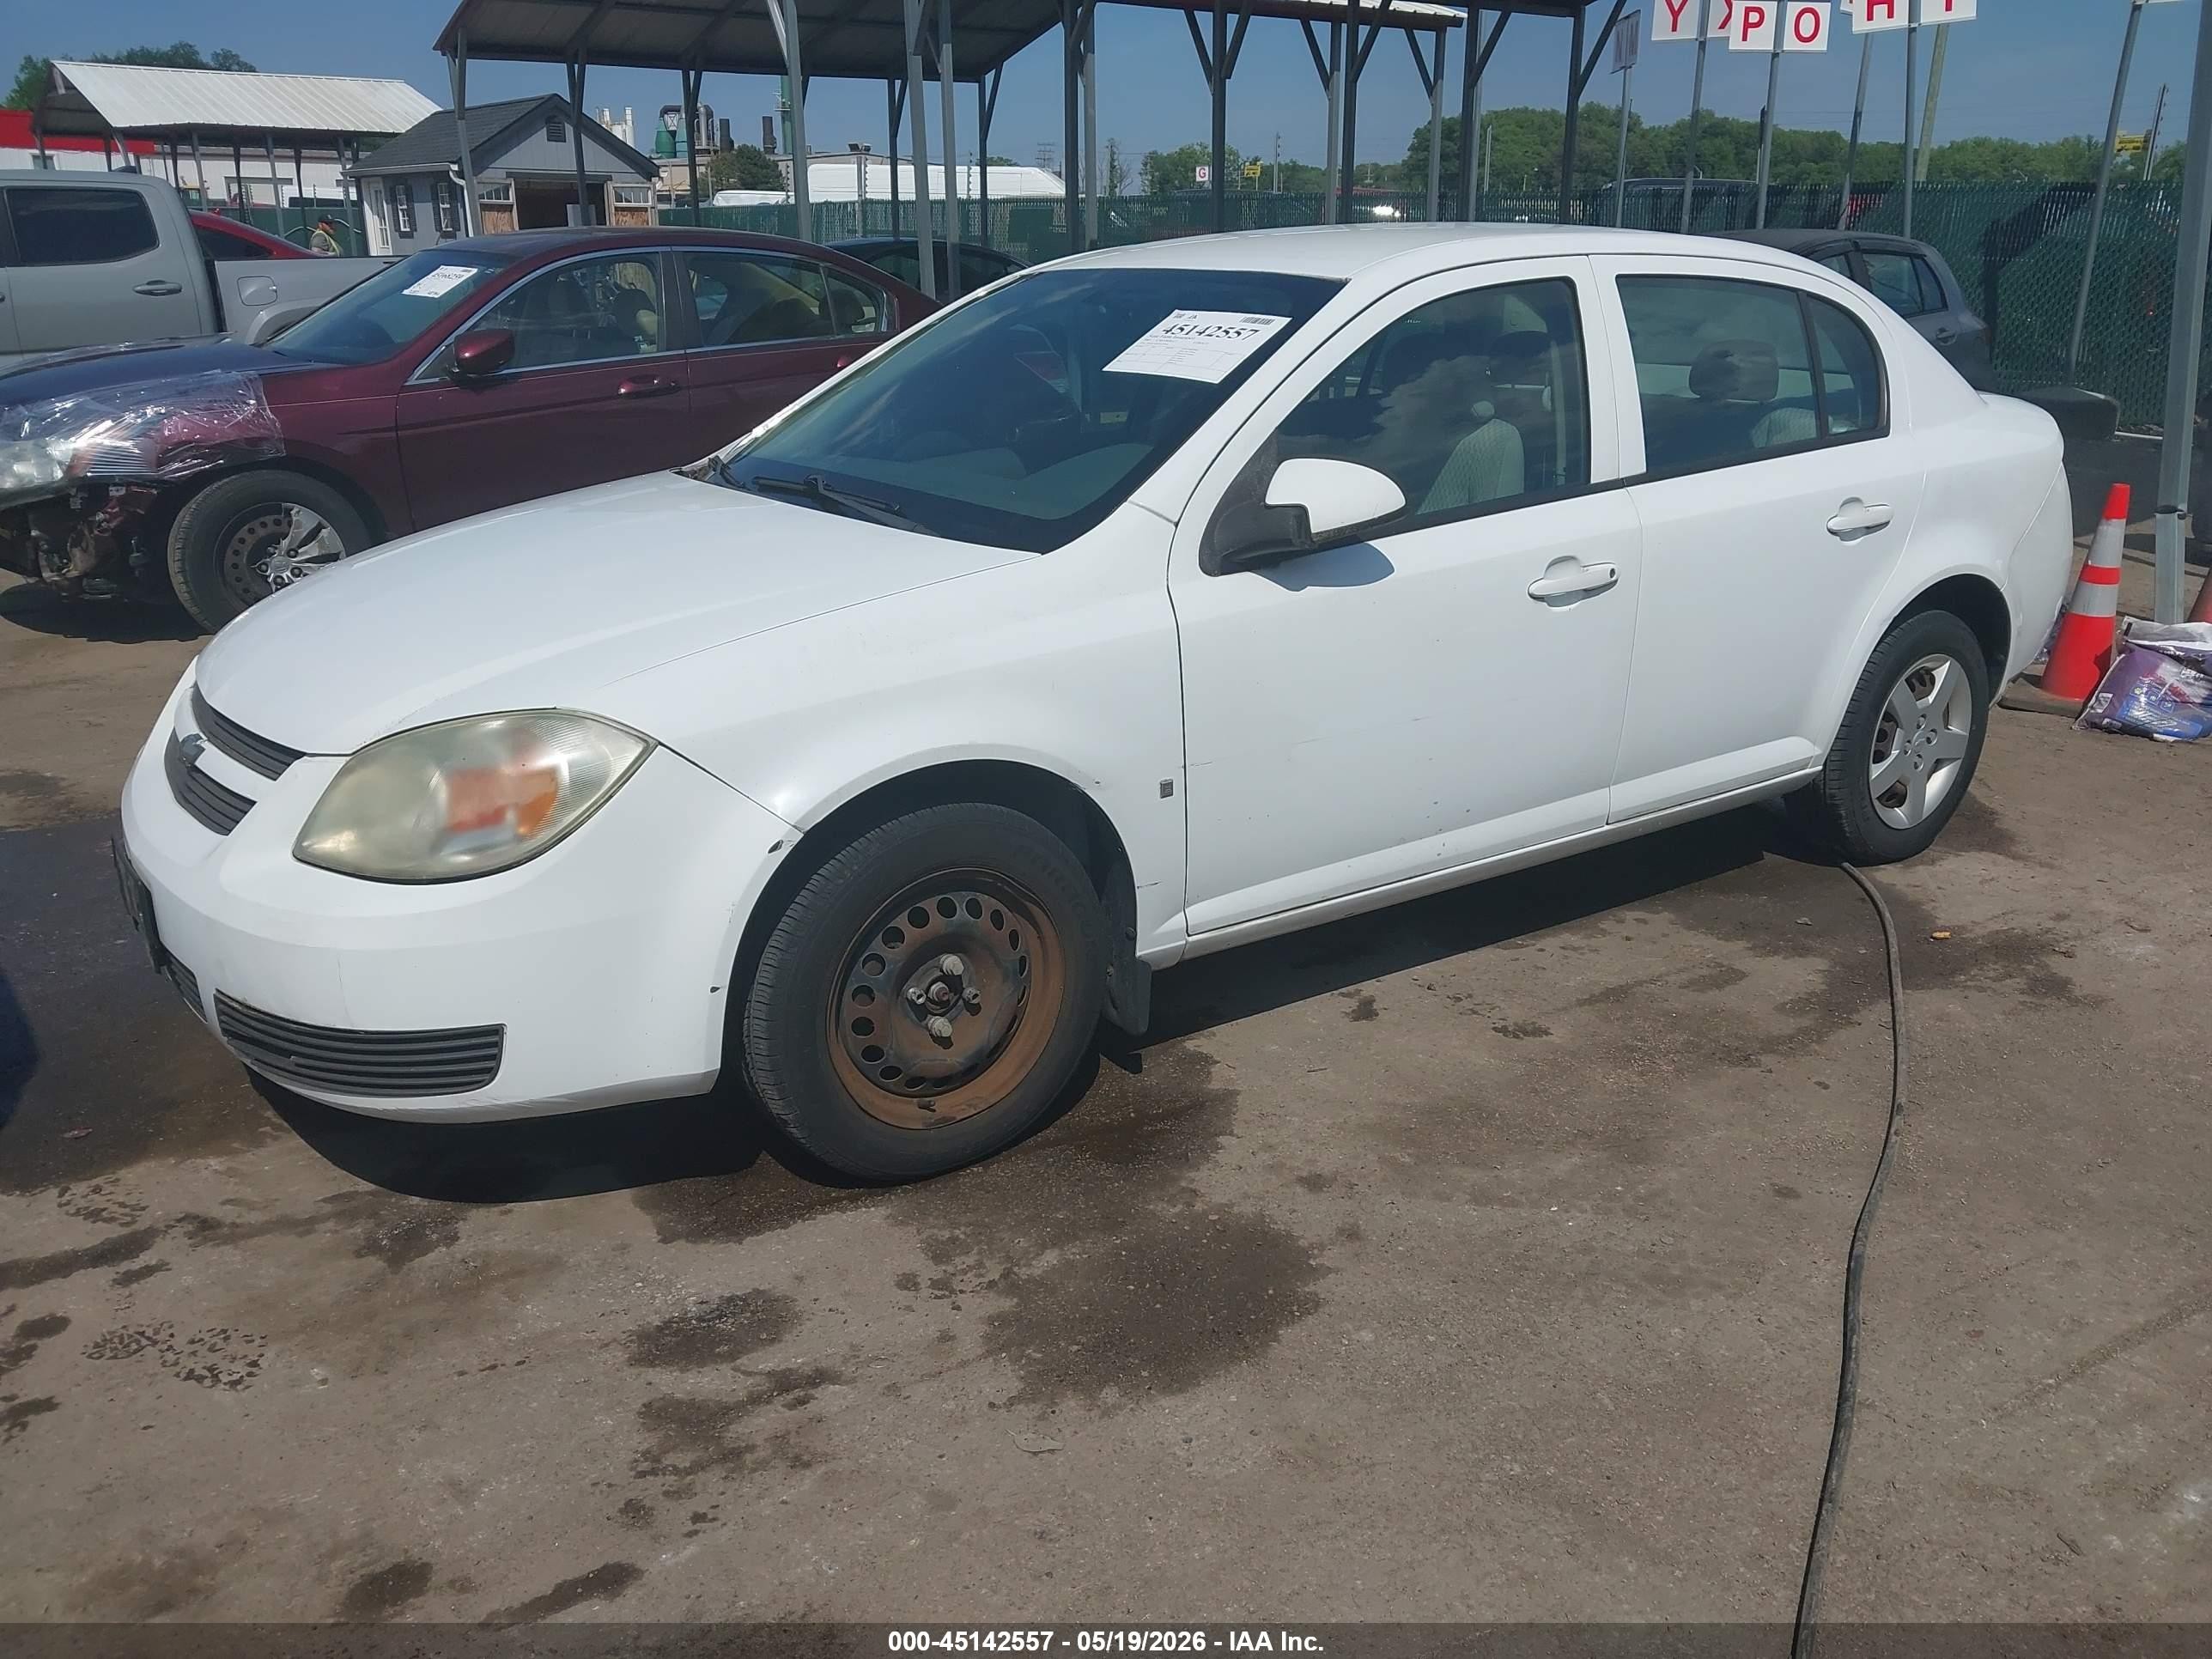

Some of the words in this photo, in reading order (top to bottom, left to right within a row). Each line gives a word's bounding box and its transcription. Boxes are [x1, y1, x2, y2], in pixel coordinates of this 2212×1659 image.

[1741, 6, 1765, 42] P
[1794, 6, 1820, 44] O
[1198, 167, 1206, 179] G
[1162, 323, 1260, 340] 45142557
